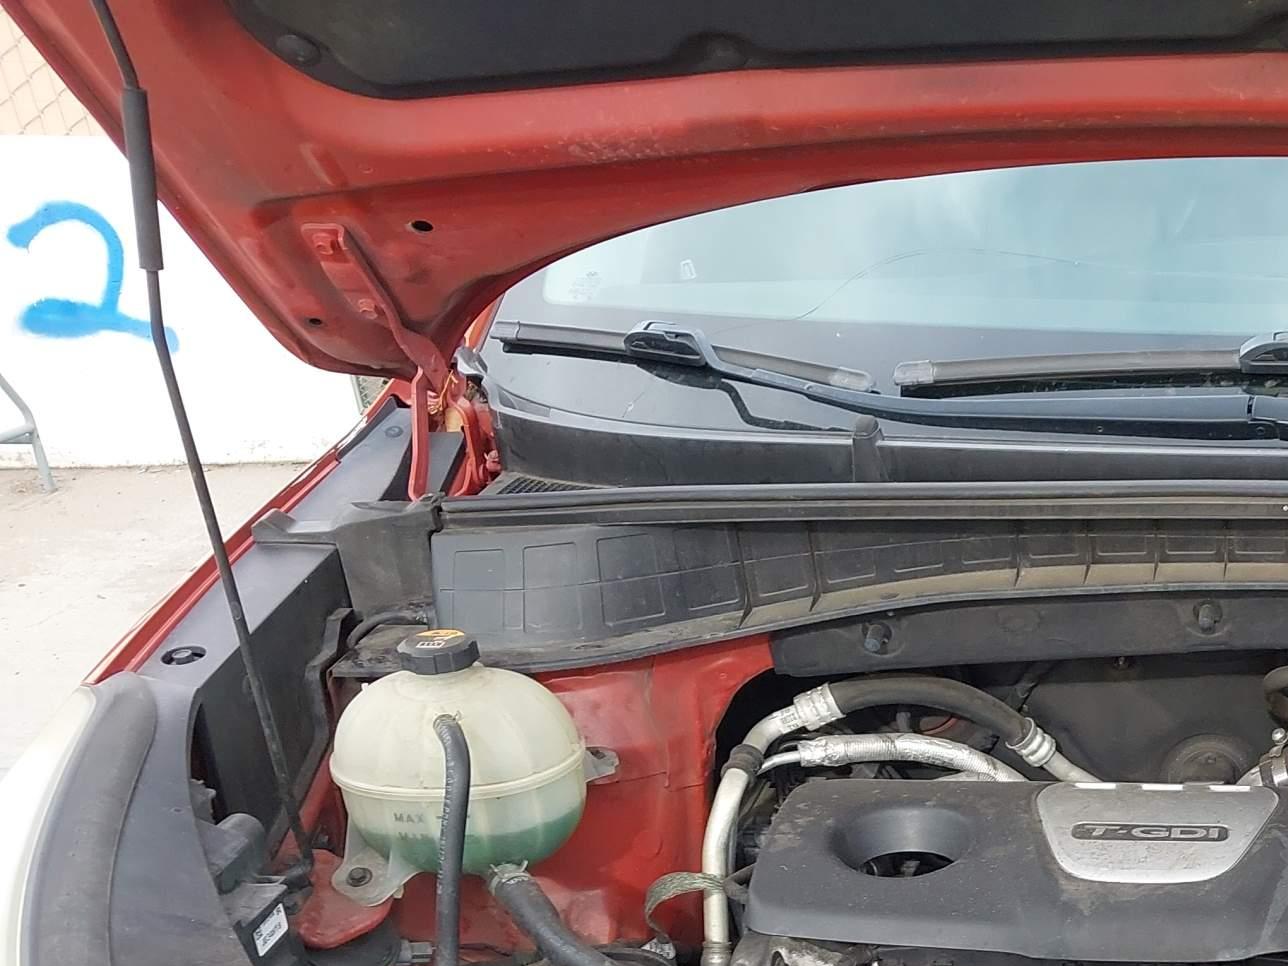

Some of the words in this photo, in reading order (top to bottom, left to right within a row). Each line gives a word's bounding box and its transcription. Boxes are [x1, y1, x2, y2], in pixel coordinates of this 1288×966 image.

[6, 200, 179, 354] 2
[393, 812, 424, 824] MAX
[1083, 824, 1222, 840] T-GDI
